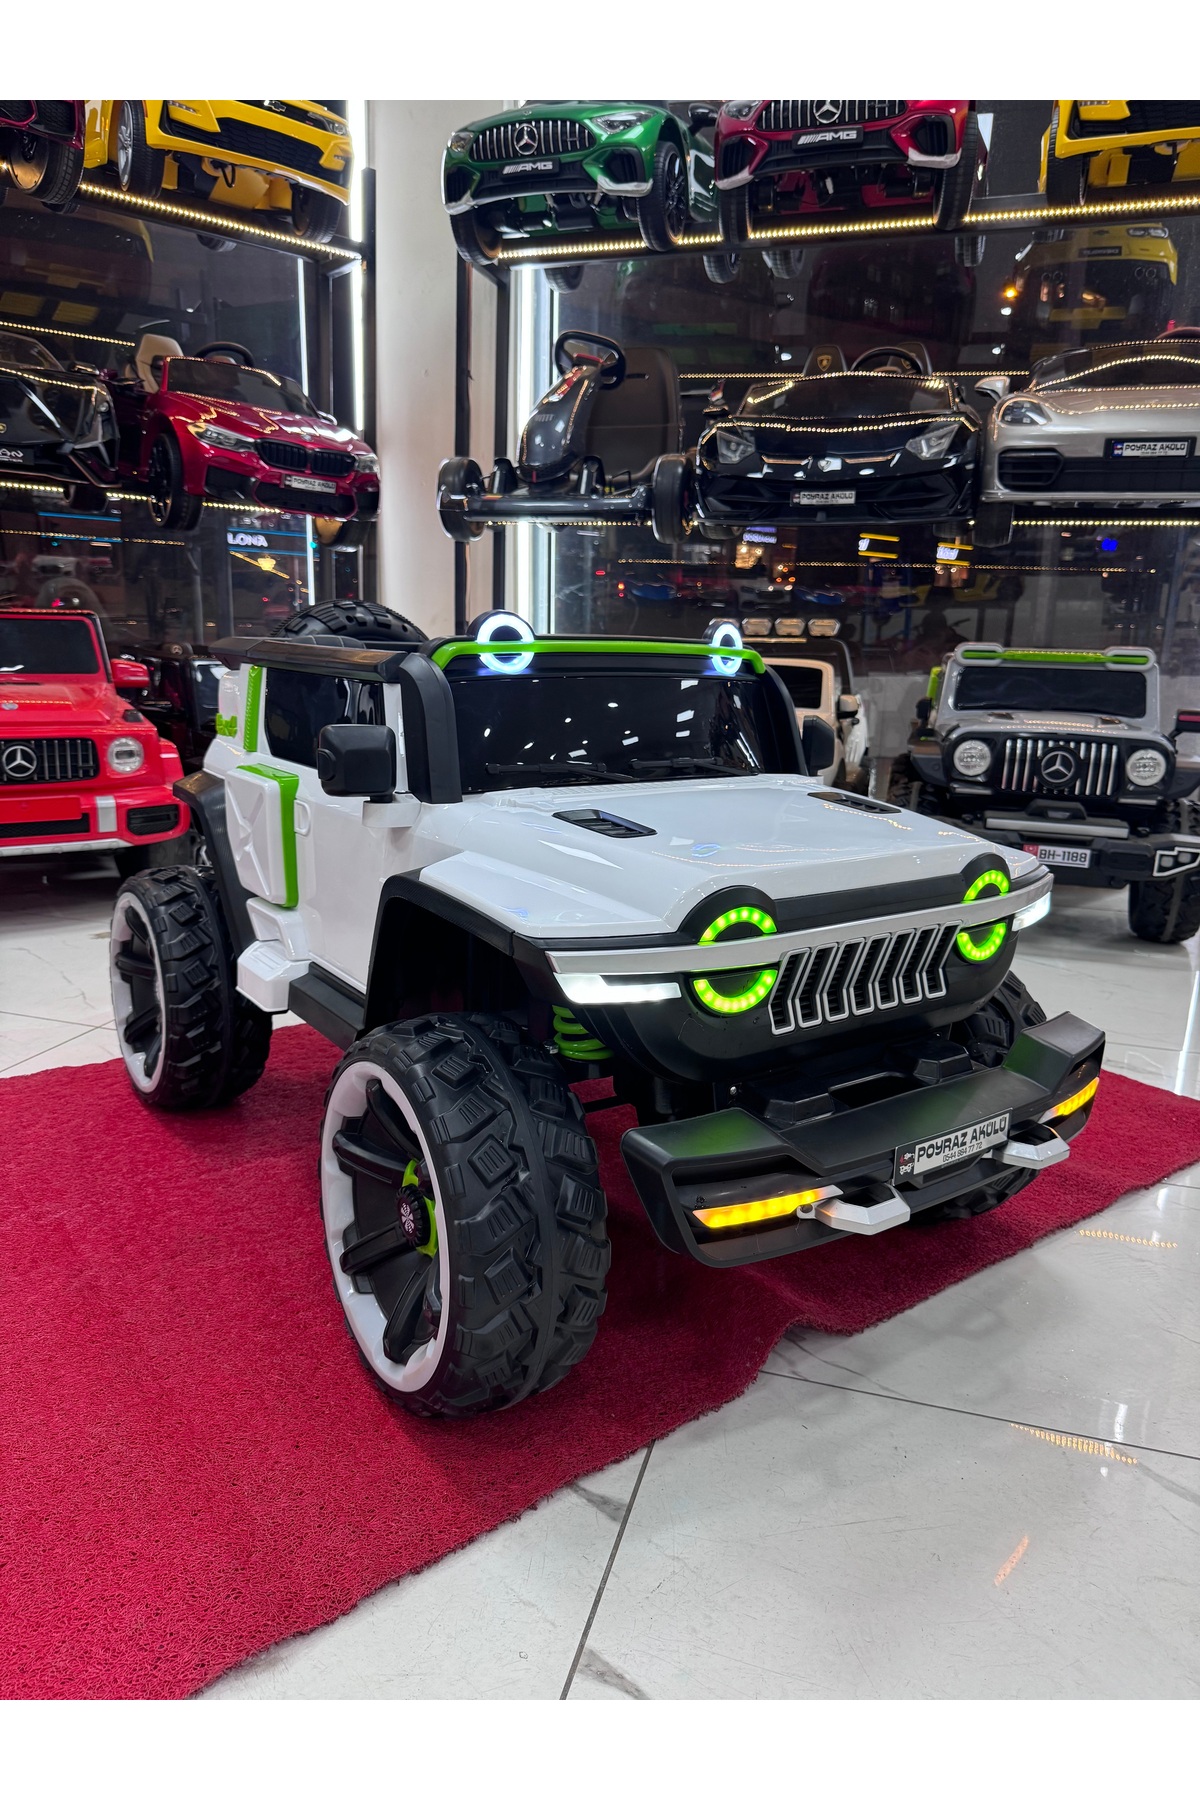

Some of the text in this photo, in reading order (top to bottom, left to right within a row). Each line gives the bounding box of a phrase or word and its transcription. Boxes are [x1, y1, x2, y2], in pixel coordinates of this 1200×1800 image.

[814, 130, 857, 142] AMG
[517, 161, 553, 172] AMG
[1125, 443, 1158, 452] POYRAZ
[1039, 849, 1088, 863] BH-1188
[917, 1131, 968, 1162] POYRAZ
[970, 1116, 1007, 1142] AKÜLÜ
